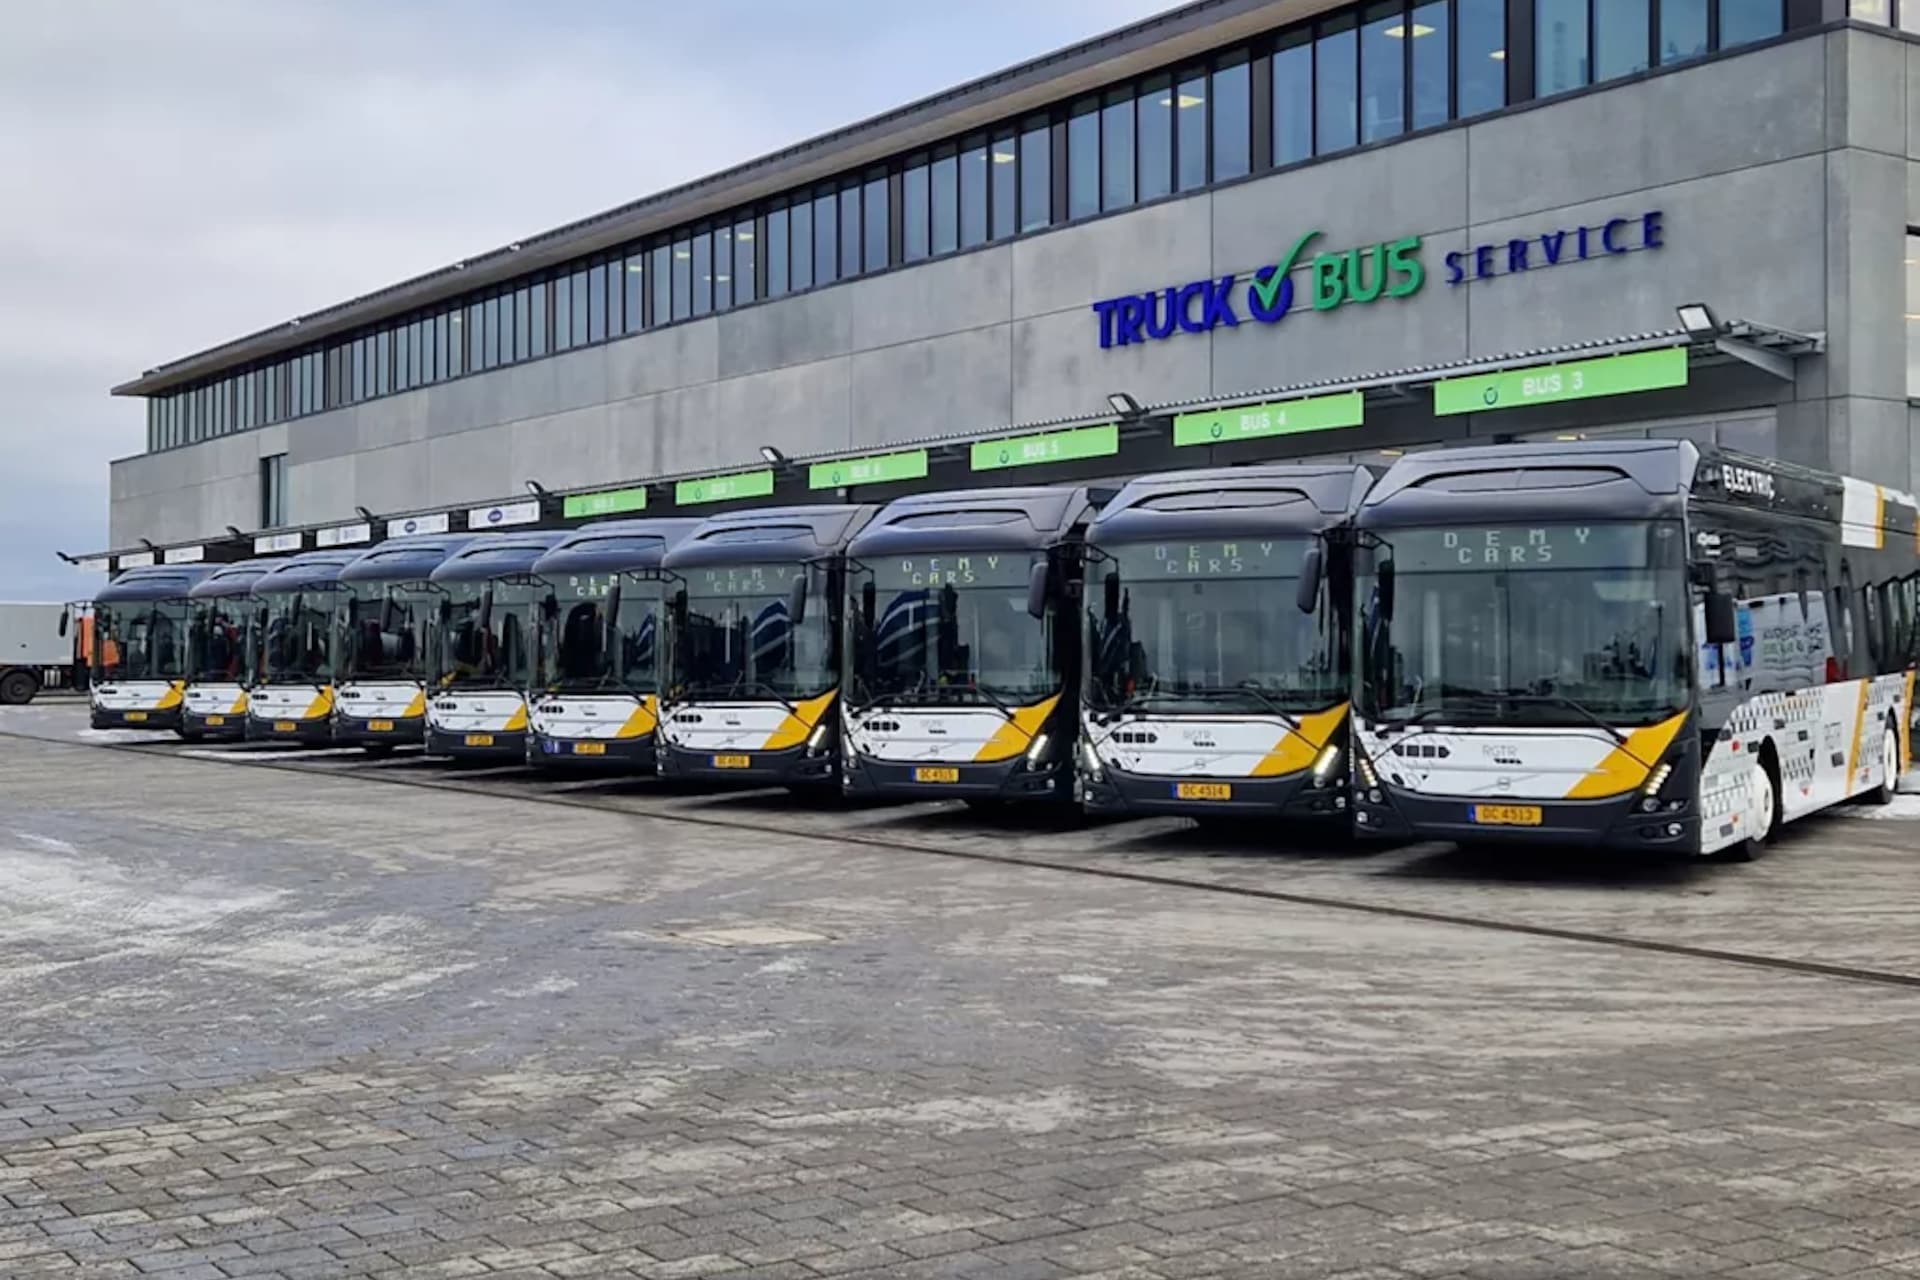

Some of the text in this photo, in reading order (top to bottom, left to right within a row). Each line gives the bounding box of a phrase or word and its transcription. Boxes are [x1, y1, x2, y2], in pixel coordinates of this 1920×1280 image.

[1093, 210, 1664, 349] TRUCK BUS SERVICE
[1522, 370, 1583, 396] BUS 3
[1240, 409, 1287, 431] BUS 4
[1721, 464, 1775, 500] ELECTRIC
[1443, 527, 1591, 548] DEMY
[1154, 542, 1273, 560] DEMY
[1458, 545, 1553, 564] CARS
[902, 556, 998, 573] DEMY
[1166, 557, 1243, 574] CARS
[912, 570, 974, 584] CARS
